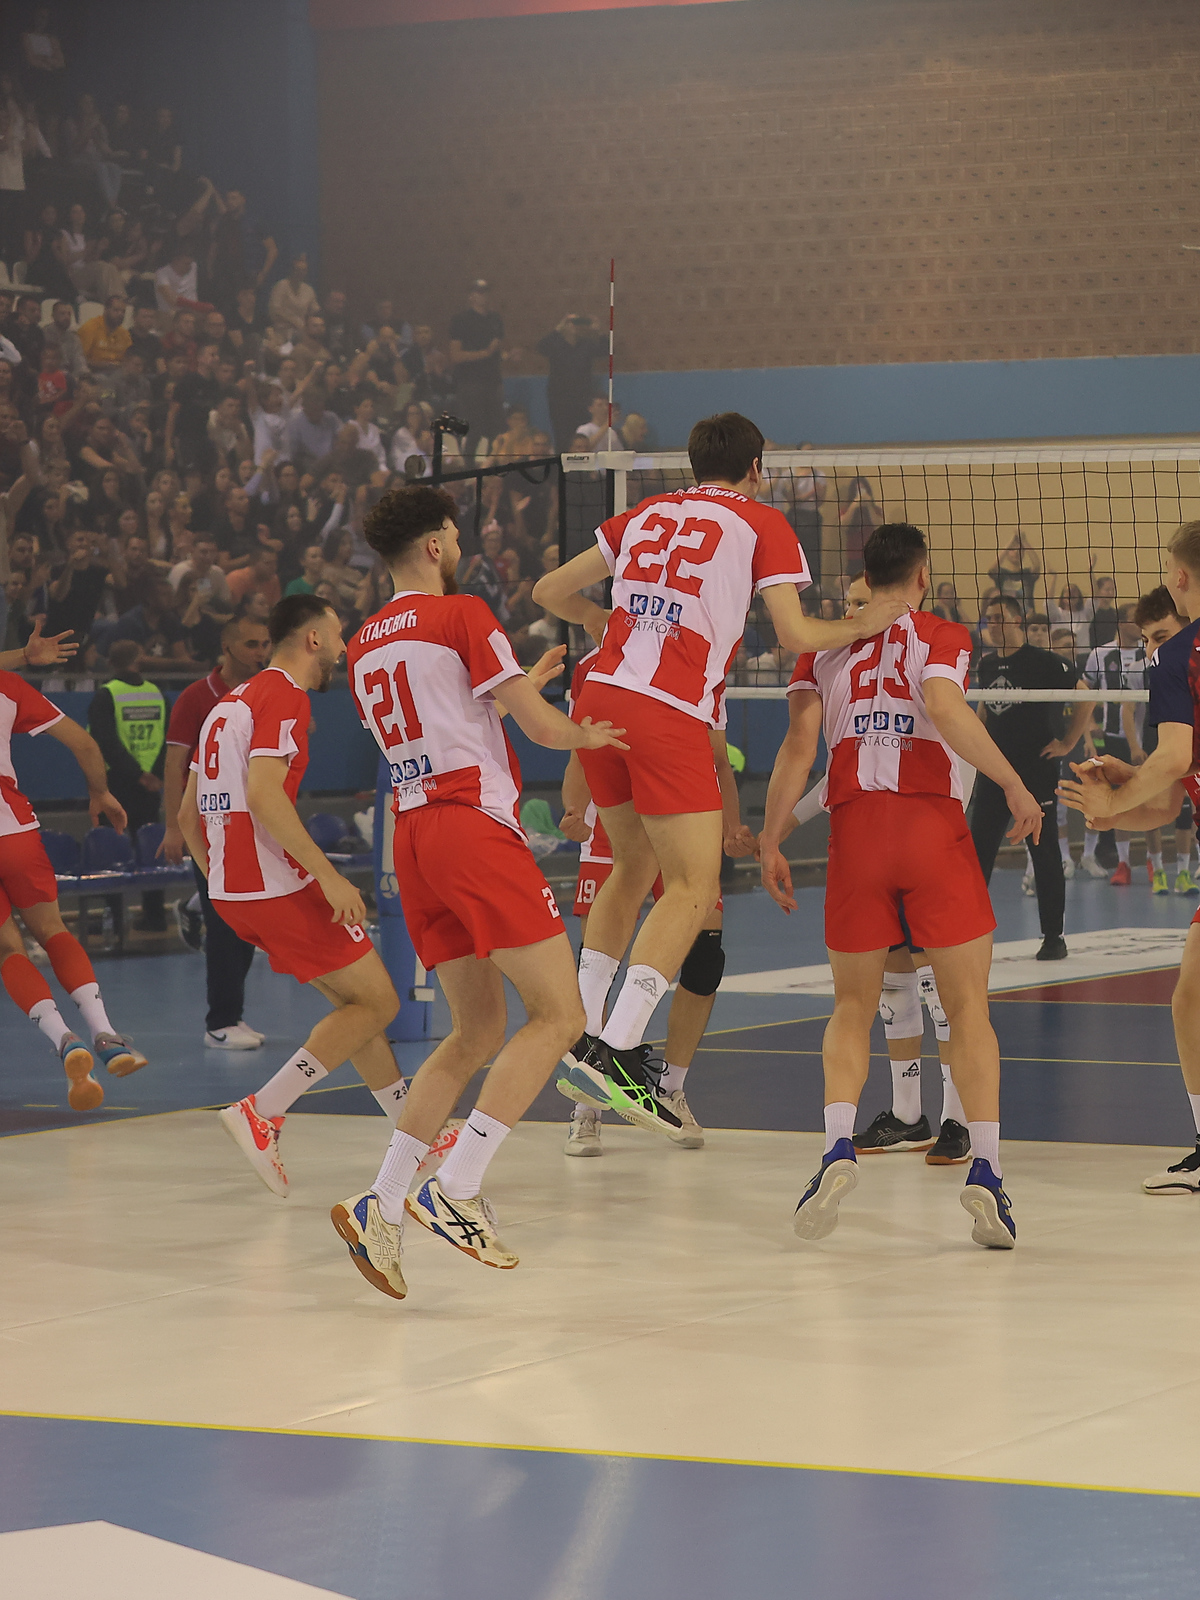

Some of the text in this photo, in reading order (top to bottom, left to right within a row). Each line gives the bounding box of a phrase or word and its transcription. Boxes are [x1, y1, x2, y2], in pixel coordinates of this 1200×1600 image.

[622, 513, 724, 599] 22
[849, 622, 914, 705] 23
[363, 659, 425, 751] 21
[855, 711, 915, 735] KBV
[204, 716, 229, 780] 6
[576, 879, 597, 904] 19
[633, 978, 660, 1000] PEAK
[295, 1060, 316, 1078] 23
[902, 1070, 920, 1078] PEA
